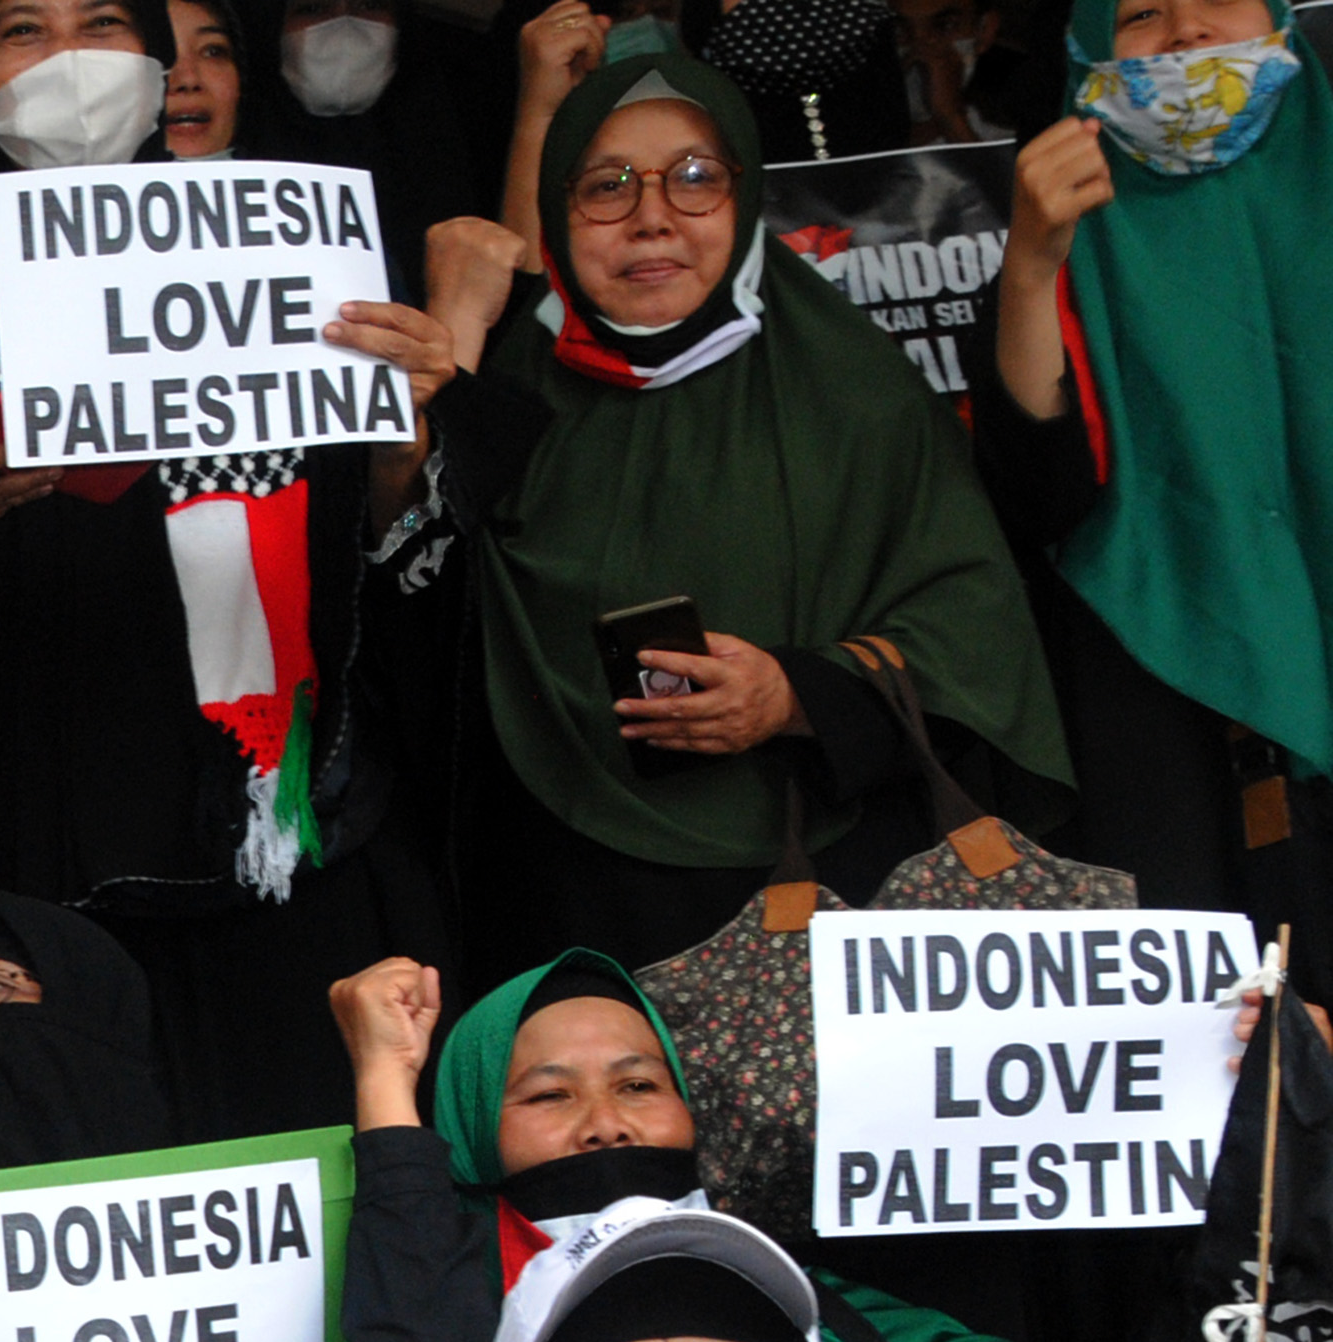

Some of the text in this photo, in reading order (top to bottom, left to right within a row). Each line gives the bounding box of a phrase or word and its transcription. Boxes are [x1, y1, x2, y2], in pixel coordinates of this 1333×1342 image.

[17, 178, 373, 261] INDONESIA
[848, 228, 1009, 305] INDON
[103, 275, 317, 355] LOVE
[870, 305, 928, 332] KAN
[22, 363, 407, 458] PALESTINA
[843, 927, 1245, 1016] INDONESIA
[933, 1038, 1165, 1119] LOVE
[838, 1138, 1209, 1227] PALESTIN
